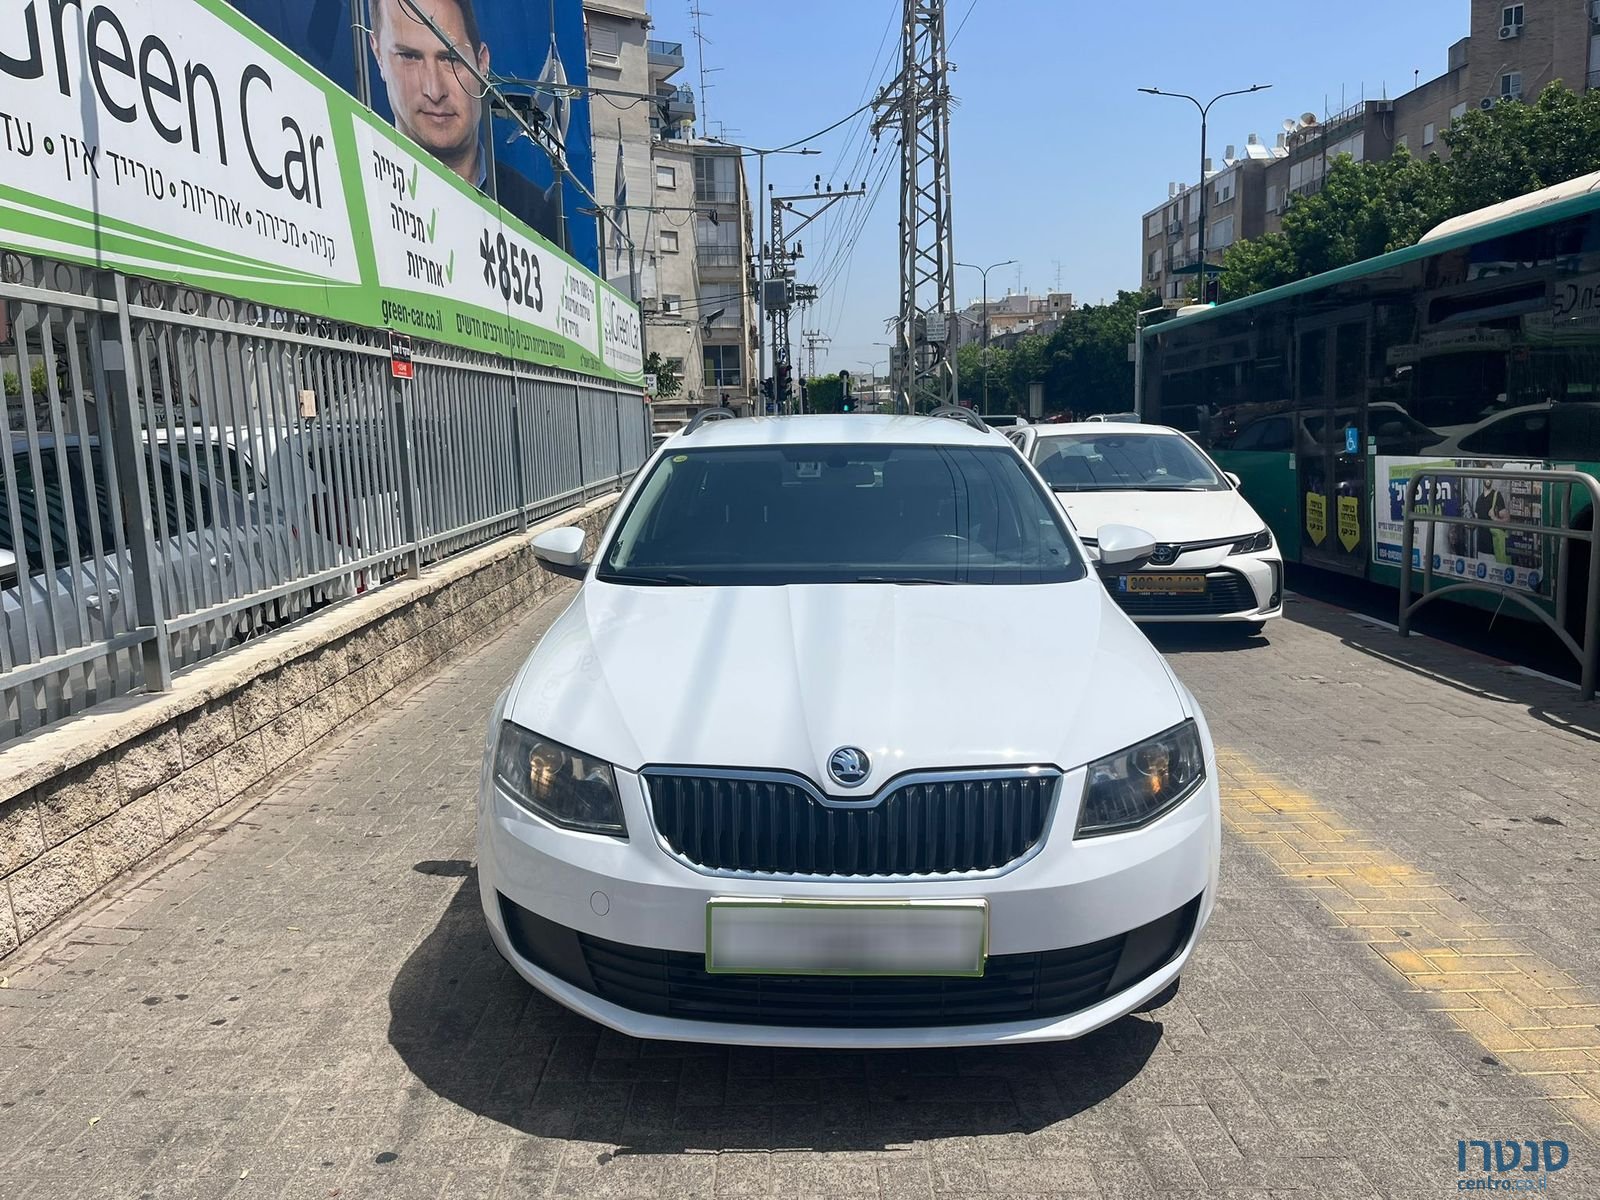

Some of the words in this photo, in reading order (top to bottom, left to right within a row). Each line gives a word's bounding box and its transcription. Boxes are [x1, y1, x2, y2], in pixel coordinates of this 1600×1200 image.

[240, 64, 324, 209] Car
[60, 134, 100, 181] אין
[105, 150, 164, 200] טרייד
[372, 149, 406, 200] קנייה
[181, 179, 243, 229] אחריות
[390, 202, 426, 243] מכירה
[256, 208, 300, 249] מכירה
[309, 230, 335, 266] קניה
[406, 250, 445, 288] אחריות
[381, 298, 443, 332] green-car.co.il
[456, 313, 482, 338] חדשים
[482, 321, 503, 344] ורכבים
